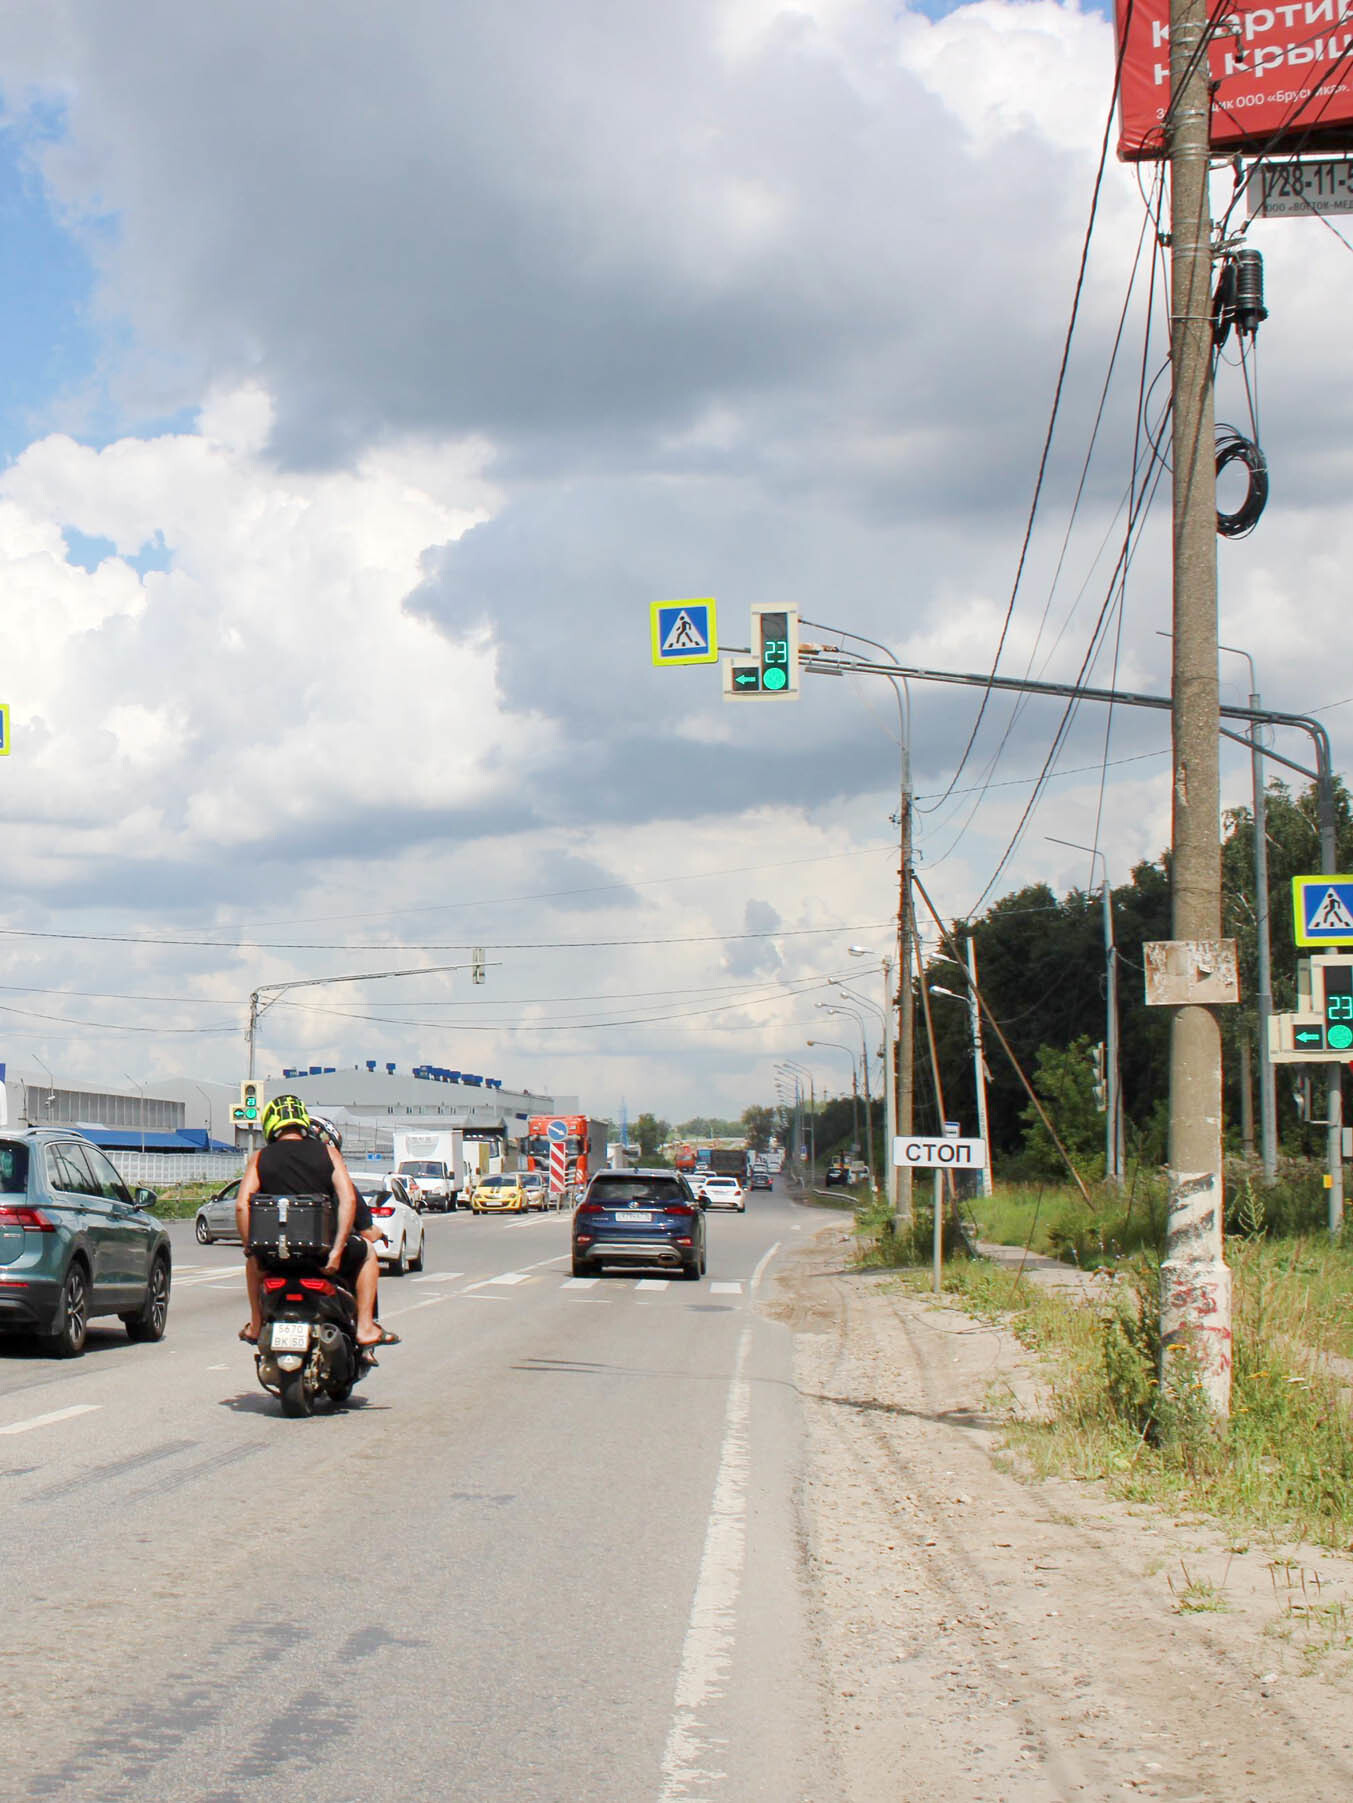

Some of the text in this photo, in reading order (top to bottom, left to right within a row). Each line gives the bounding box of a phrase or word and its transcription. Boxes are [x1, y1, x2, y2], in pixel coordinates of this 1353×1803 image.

[1236, 93, 1264, 108] ООО
[764, 641, 787, 663] 23
[1328, 996, 1353, 1020] 23
[905, 1143, 971, 1163] СТОП
